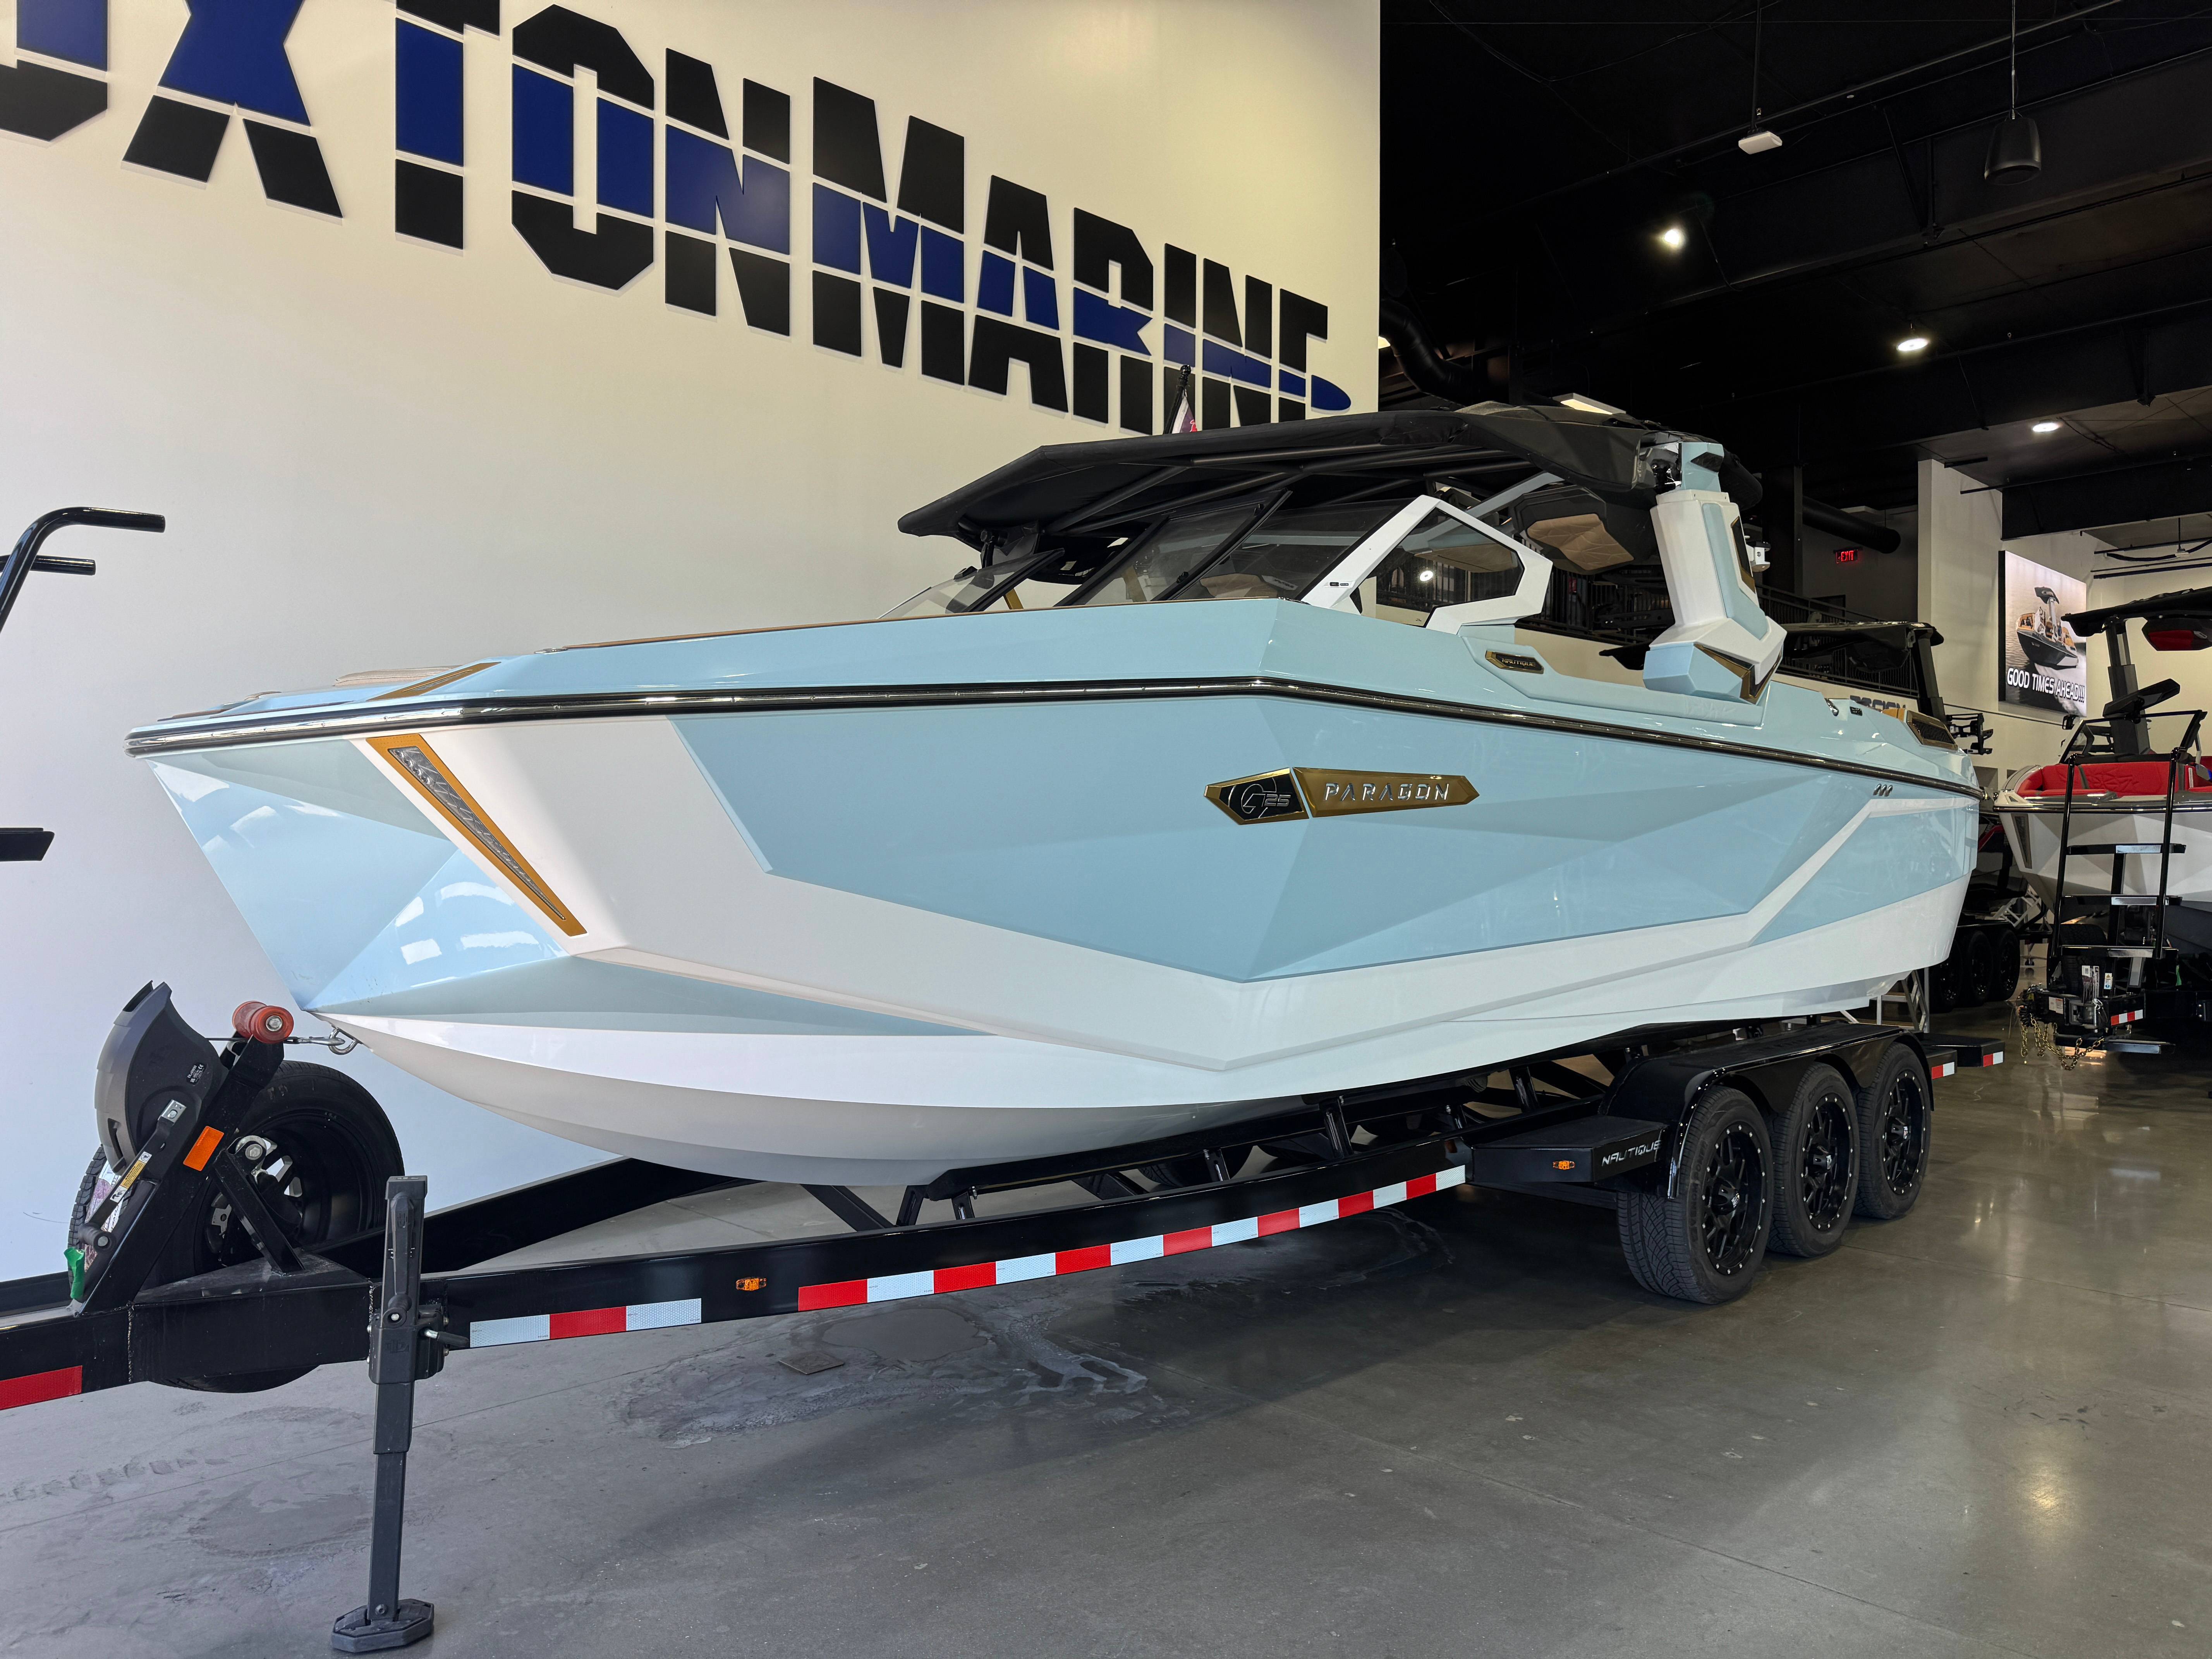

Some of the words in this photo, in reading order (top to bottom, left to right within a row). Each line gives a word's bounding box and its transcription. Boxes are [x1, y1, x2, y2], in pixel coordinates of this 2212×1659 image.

[1841, 551, 1854, 562] EXIT
[1502, 658, 1537, 667] NAUTIQUE
[2007, 667, 2030, 688] GOOD
[2032, 673, 2054, 695] TIMES
[2056, 679, 2085, 703] AHEAD!!!
[1324, 782, 1450, 802] PARAGON
[1601, 1140, 1661, 1166] NAUTIQUE
